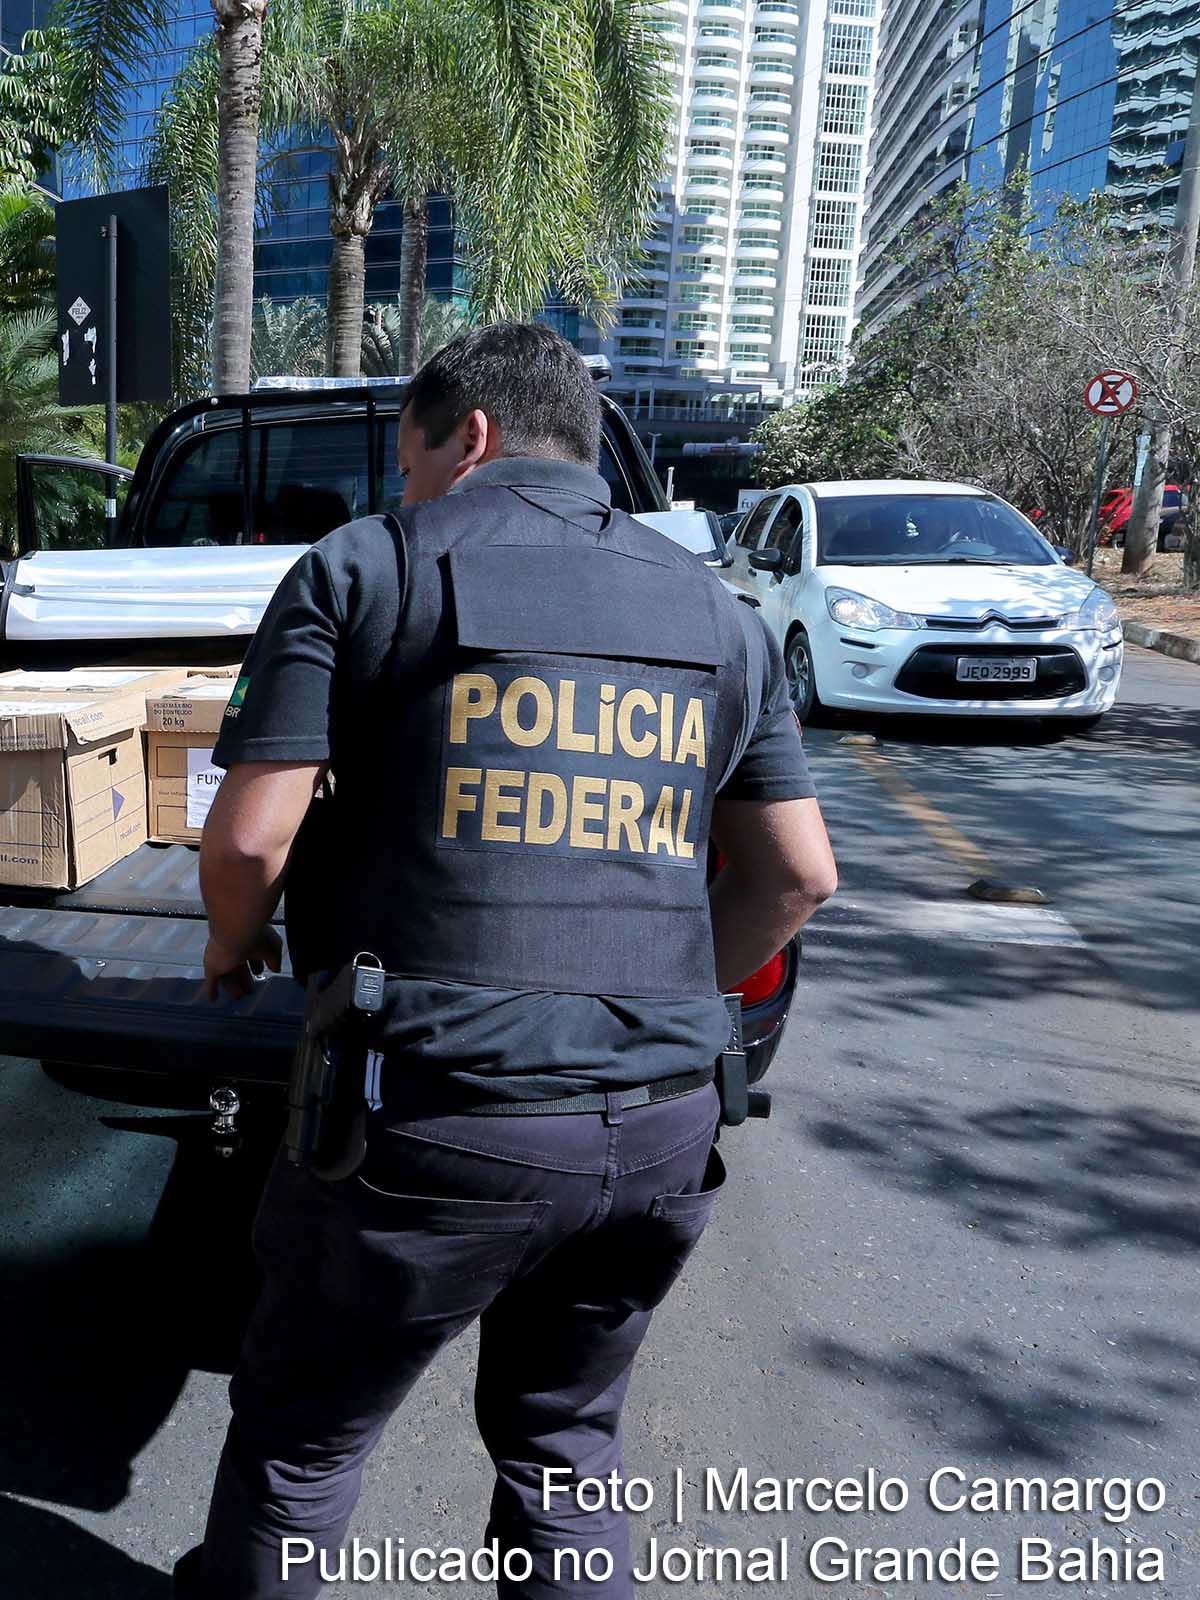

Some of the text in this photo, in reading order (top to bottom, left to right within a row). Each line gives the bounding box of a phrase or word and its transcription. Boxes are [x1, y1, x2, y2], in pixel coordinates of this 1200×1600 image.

[162, 717, 185, 728] 20 kg
[448, 672, 707, 768] POLÍCIA
[441, 767, 696, 859] FEDERAL
